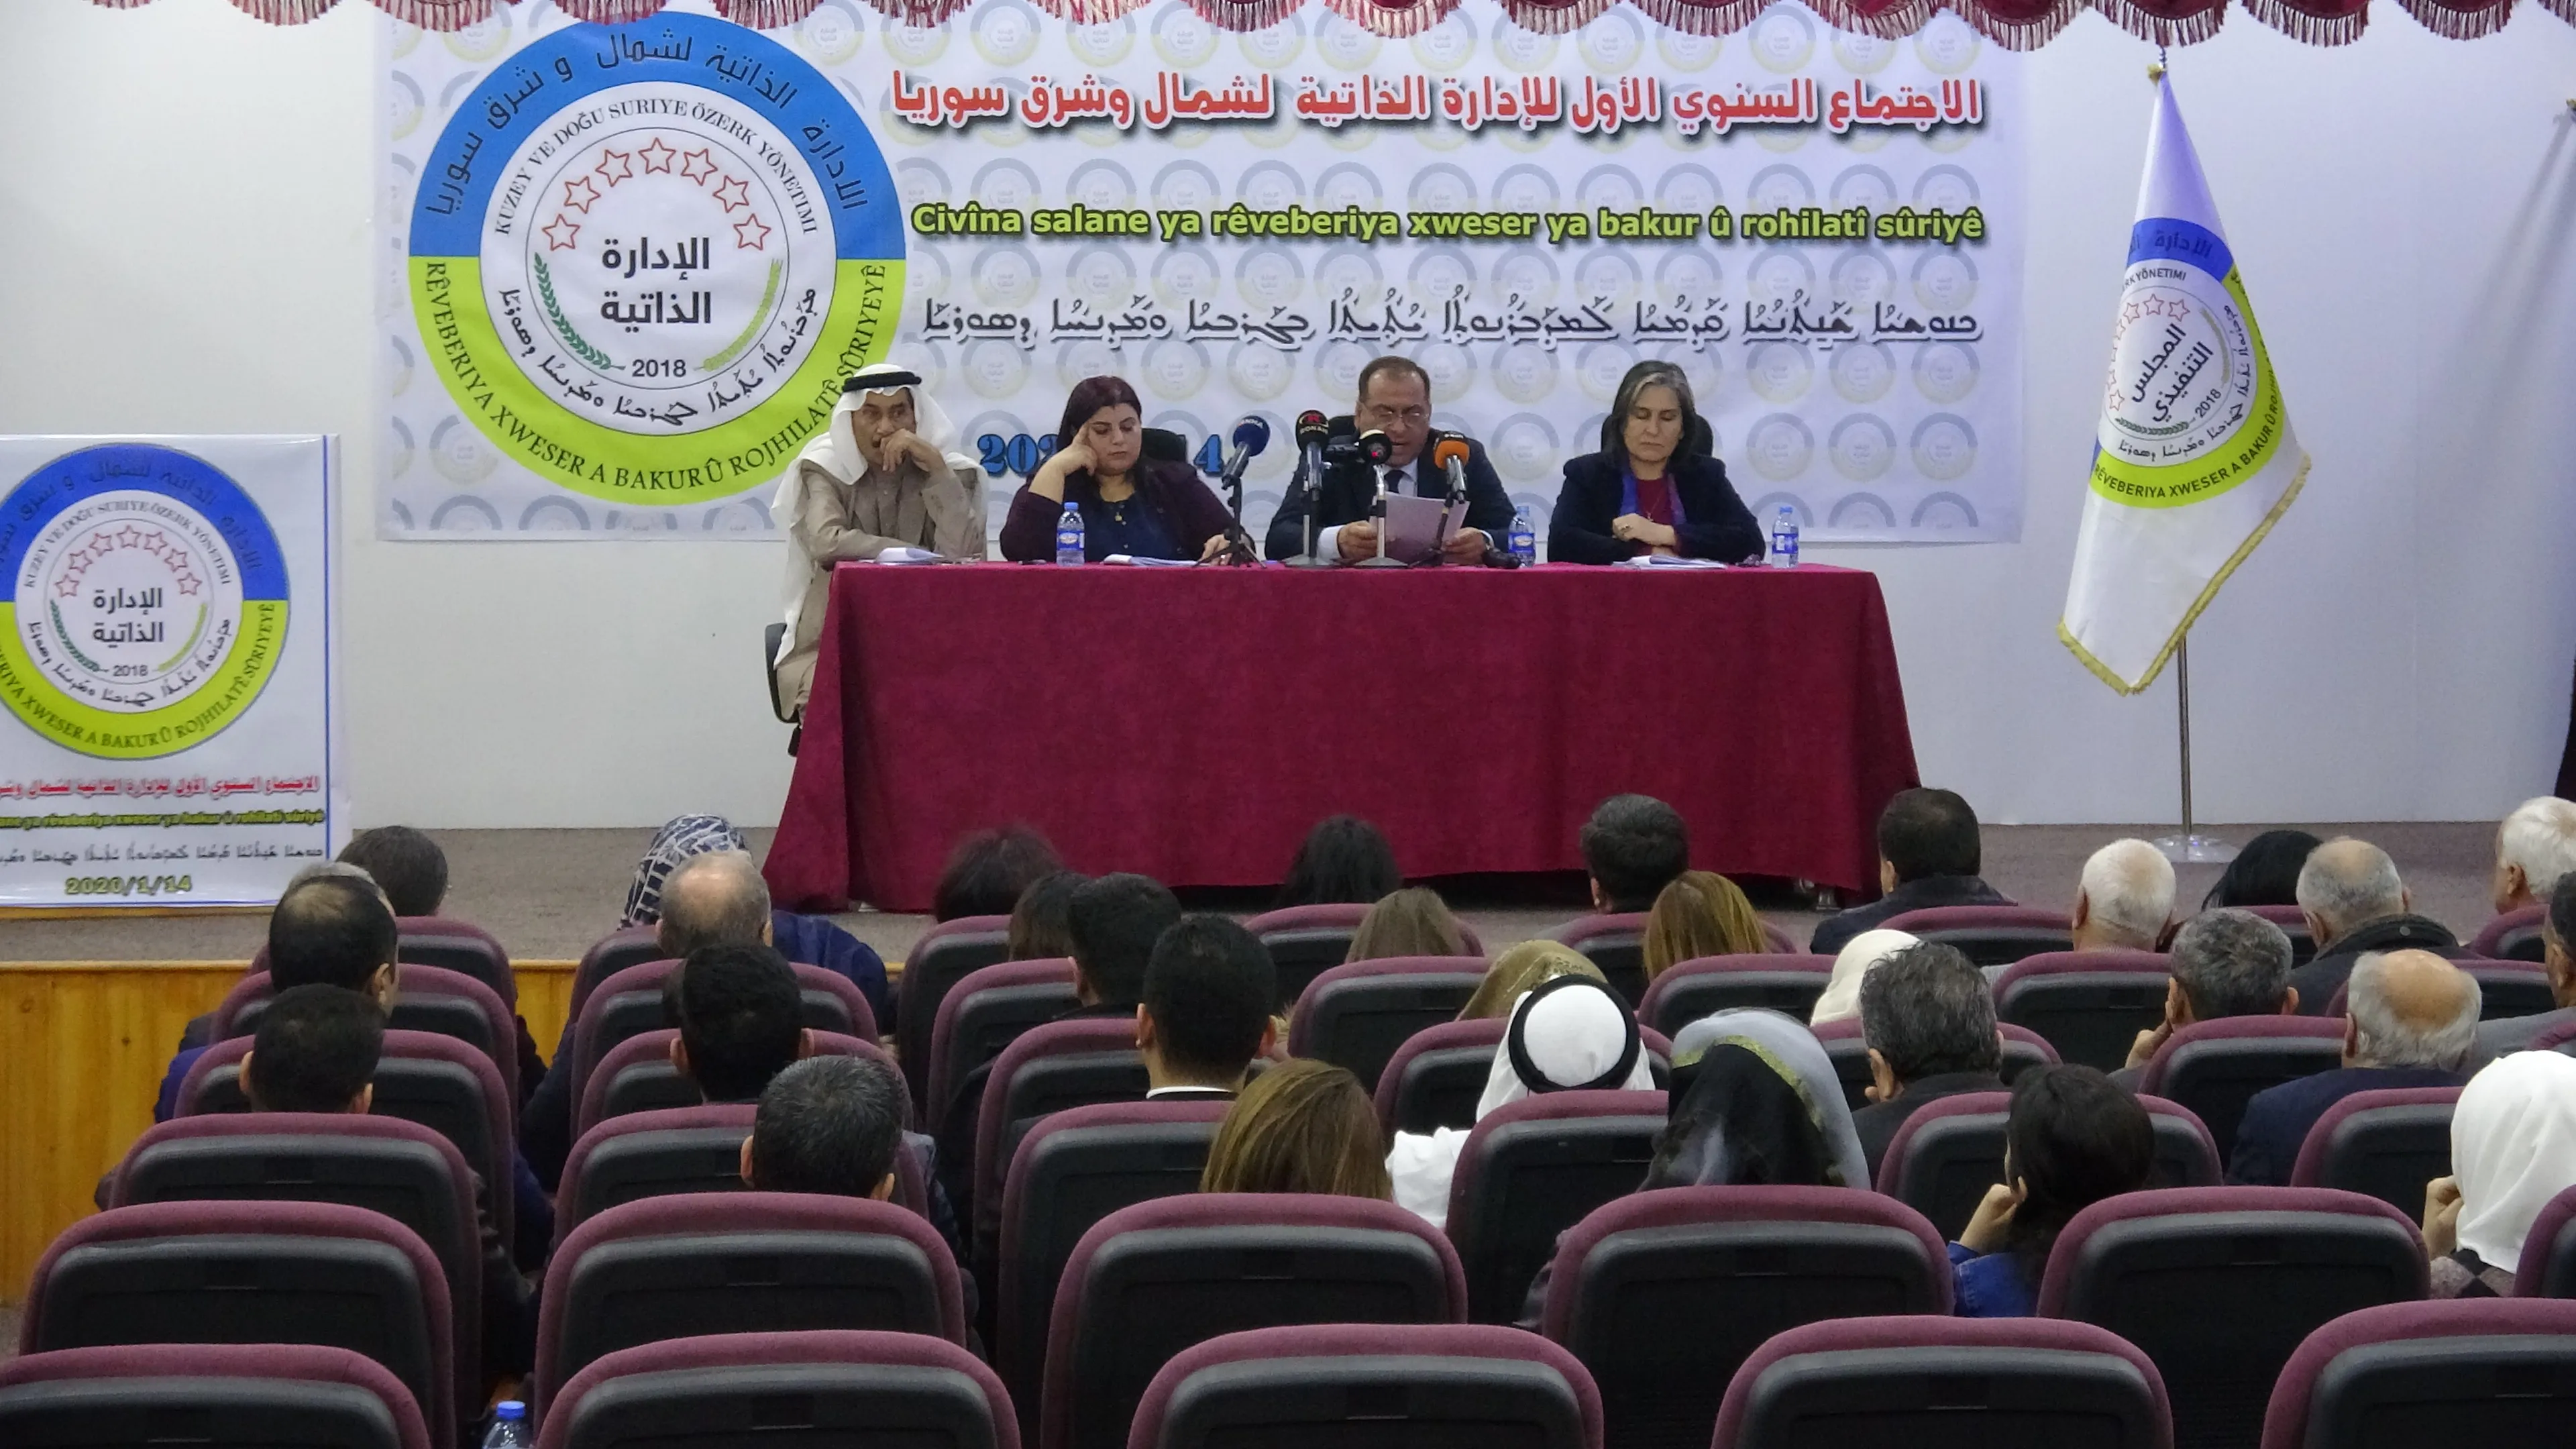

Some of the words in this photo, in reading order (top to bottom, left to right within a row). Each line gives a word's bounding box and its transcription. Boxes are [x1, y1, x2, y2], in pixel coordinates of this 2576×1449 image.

[596, 29, 692, 70] لشمال
[484, 65, 545, 129] شرق
[706, 44, 798, 110] الذاتية
[893, 70, 1005, 123] سوريا
[1022, 74, 1131, 124] وشرق
[1144, 72, 1271, 124] لشمال
[1296, 74, 1426, 123] الذاتية
[1572, 76, 1656, 127] الأول
[1444, 77, 1558, 128] للإدارة
[1673, 78, 1813, 130] السنوي
[1829, 80, 1977, 129] الاجتماع
[425, 131, 484, 215] سوريا
[494, 167, 532, 235] KUZEY
[529, 141, 555, 166] VE
[553, 108, 604, 146] DOĞU
[608, 99, 688, 119] SURIYE
[692, 101, 756, 147] ÖZERK
[761, 142, 818, 235] YÖNETIMI
[912, 202, 1023, 233] Civîna
[1031, 204, 1149, 234] salane
[1158, 211, 1201, 240] ya
[1212, 203, 1399, 241] rêveberiya
[1409, 213, 1538, 237] xweser
[1546, 214, 1589, 242] ya
[1599, 208, 1700, 237] bakur
[1709, 207, 1731, 237] û
[1743, 208, 1868, 237] rohilatî
[1876, 207, 1982, 243] sûriyê
[601, 236, 710, 280] الإدارة
[600, 291, 712, 334] الذاتية
[425, 261, 493, 411] RÊVEBERIYA
[489, 404, 586, 478] XWESER
[589, 463, 606, 484] A
[836, 264, 886, 380] SÛRIYEYÊ
[631, 358, 687, 378] 2018
[2131, 323, 2186, 402] المجلس
[2152, 341, 2214, 423] التنفيذي
[2194, 388, 2222, 418] 2018
[2094, 463, 2166, 498] RÊVEBERIYA
[2169, 467, 2231, 497] XWESER
[2231, 462, 2242, 475] A
[93, 587, 163, 615] الإدارة
[92, 621, 164, 649] الذاتية
[112, 664, 148, 677] 2018
[65, 874, 193, 896] 2020/1/14
